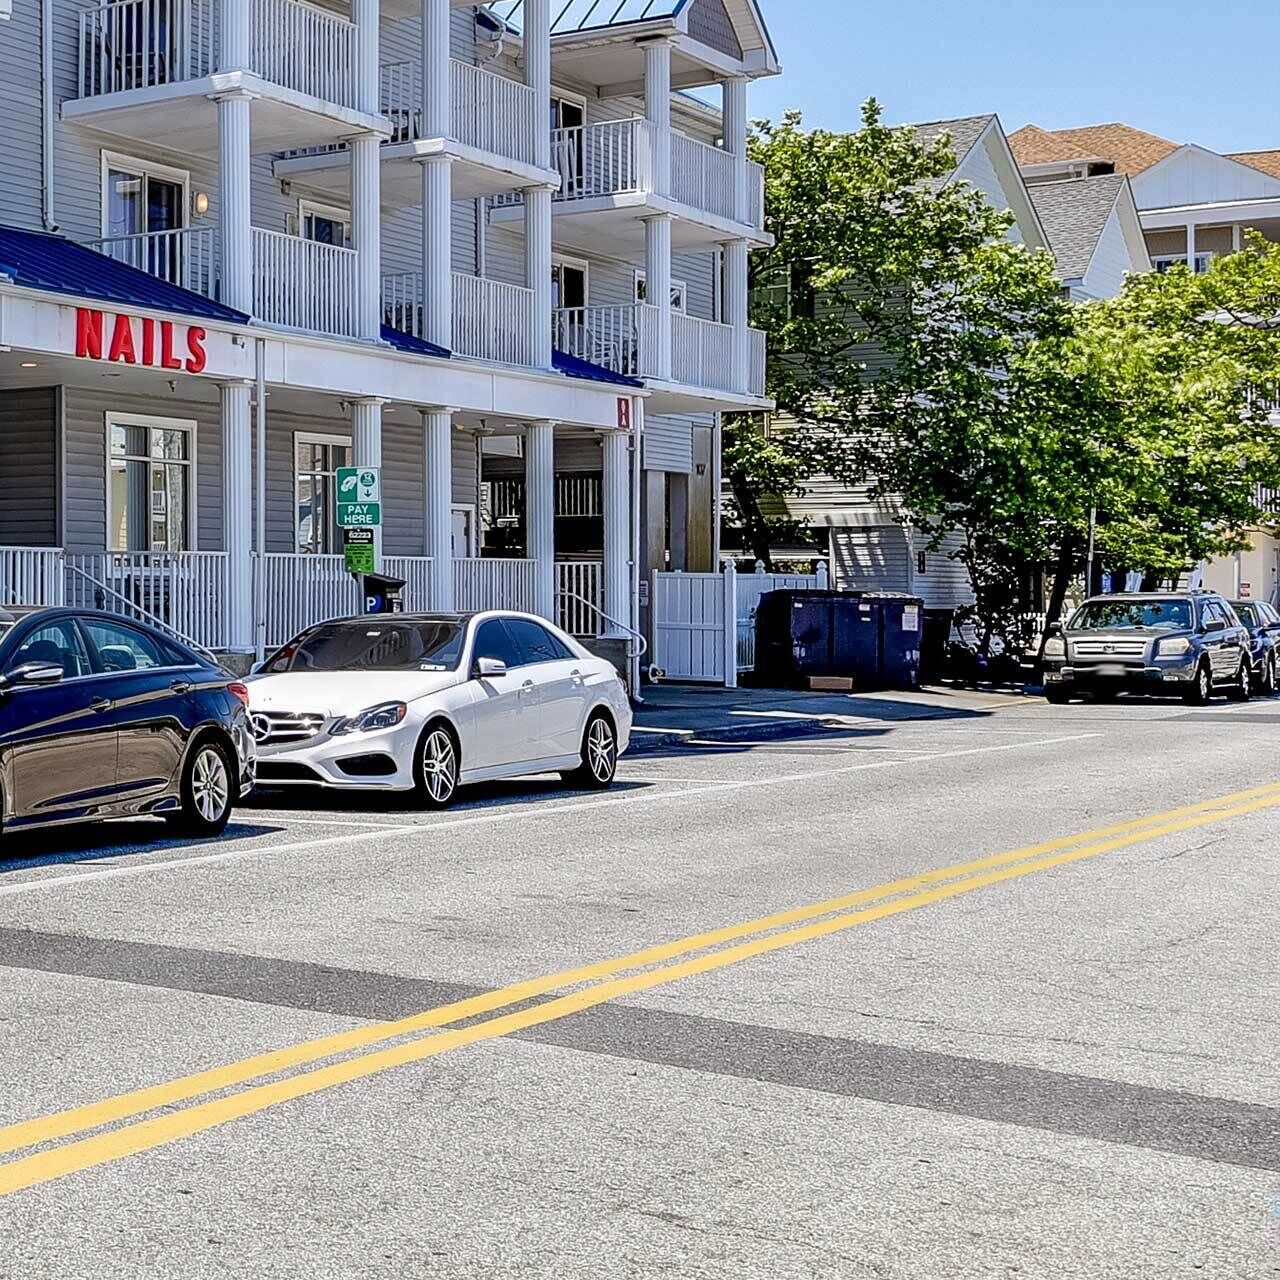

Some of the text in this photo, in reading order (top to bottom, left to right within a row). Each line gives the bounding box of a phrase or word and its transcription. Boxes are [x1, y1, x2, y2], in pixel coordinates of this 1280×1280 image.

[75, 307, 207, 374] NAILS
[347, 505, 369, 514] PAY
[344, 515, 373, 524] HERE
[366, 596, 377, 612] P
